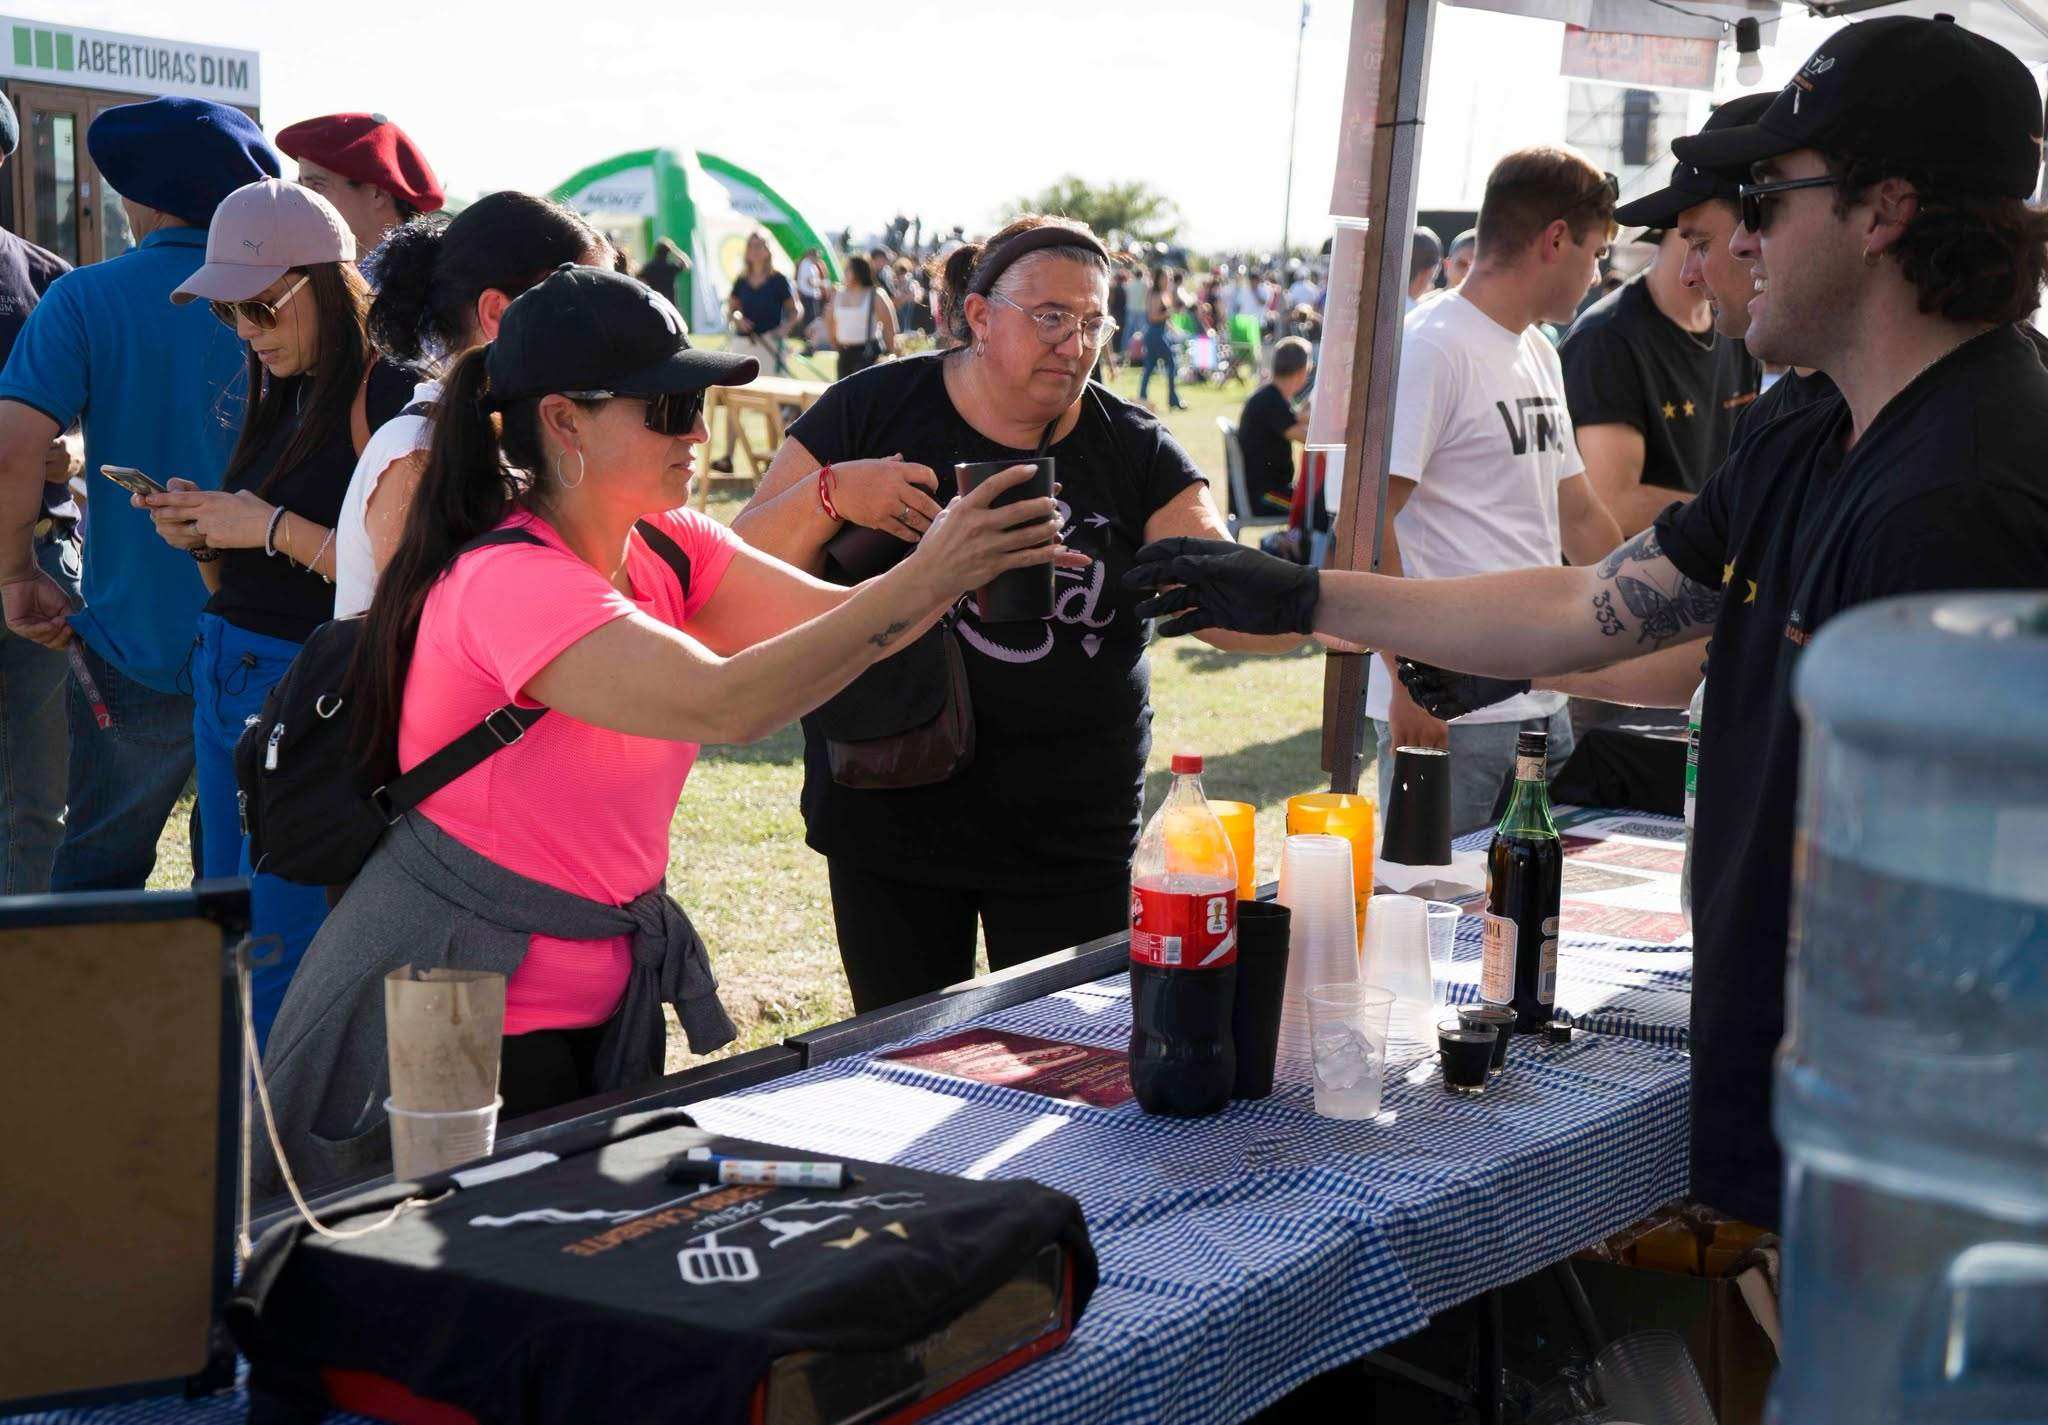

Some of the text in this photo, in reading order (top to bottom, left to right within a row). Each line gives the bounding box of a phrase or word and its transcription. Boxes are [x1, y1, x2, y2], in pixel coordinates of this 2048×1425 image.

[77, 38, 249, 90] ABERTURAS DIM
[1495, 396, 1564, 456] VN
